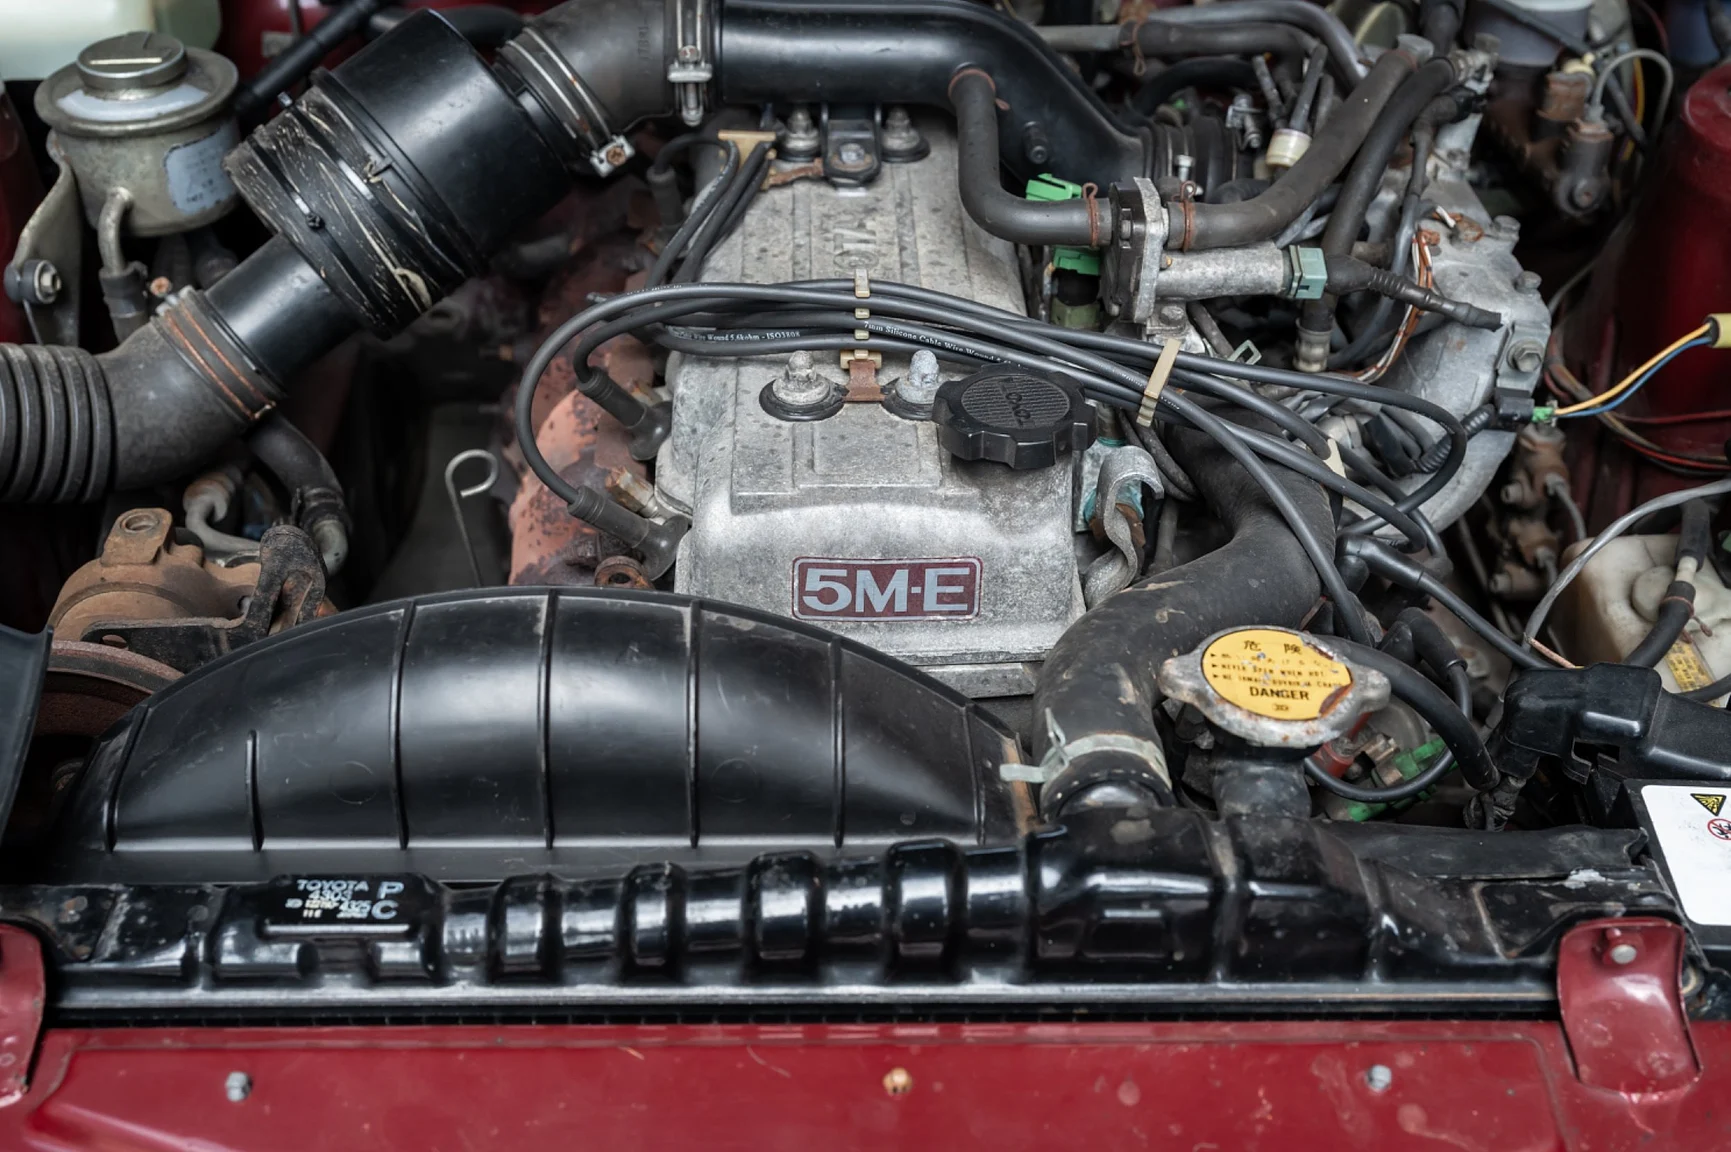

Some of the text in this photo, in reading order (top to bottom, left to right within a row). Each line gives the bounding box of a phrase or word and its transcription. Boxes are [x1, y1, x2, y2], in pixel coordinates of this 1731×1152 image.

[707, 333, 729, 342] Wound
[863, 321, 883, 332] 7mm
[885, 326, 917, 340] Silicone
[918, 335, 942, 347] Cable
[944, 341, 964, 352] Wire
[802, 567, 970, 613] 5M-E
[1249, 686, 1309, 700] DANGER
[296, 879, 369, 892] TOYOTA
[377, 880, 405, 899] P
[371, 899, 399, 920] C
